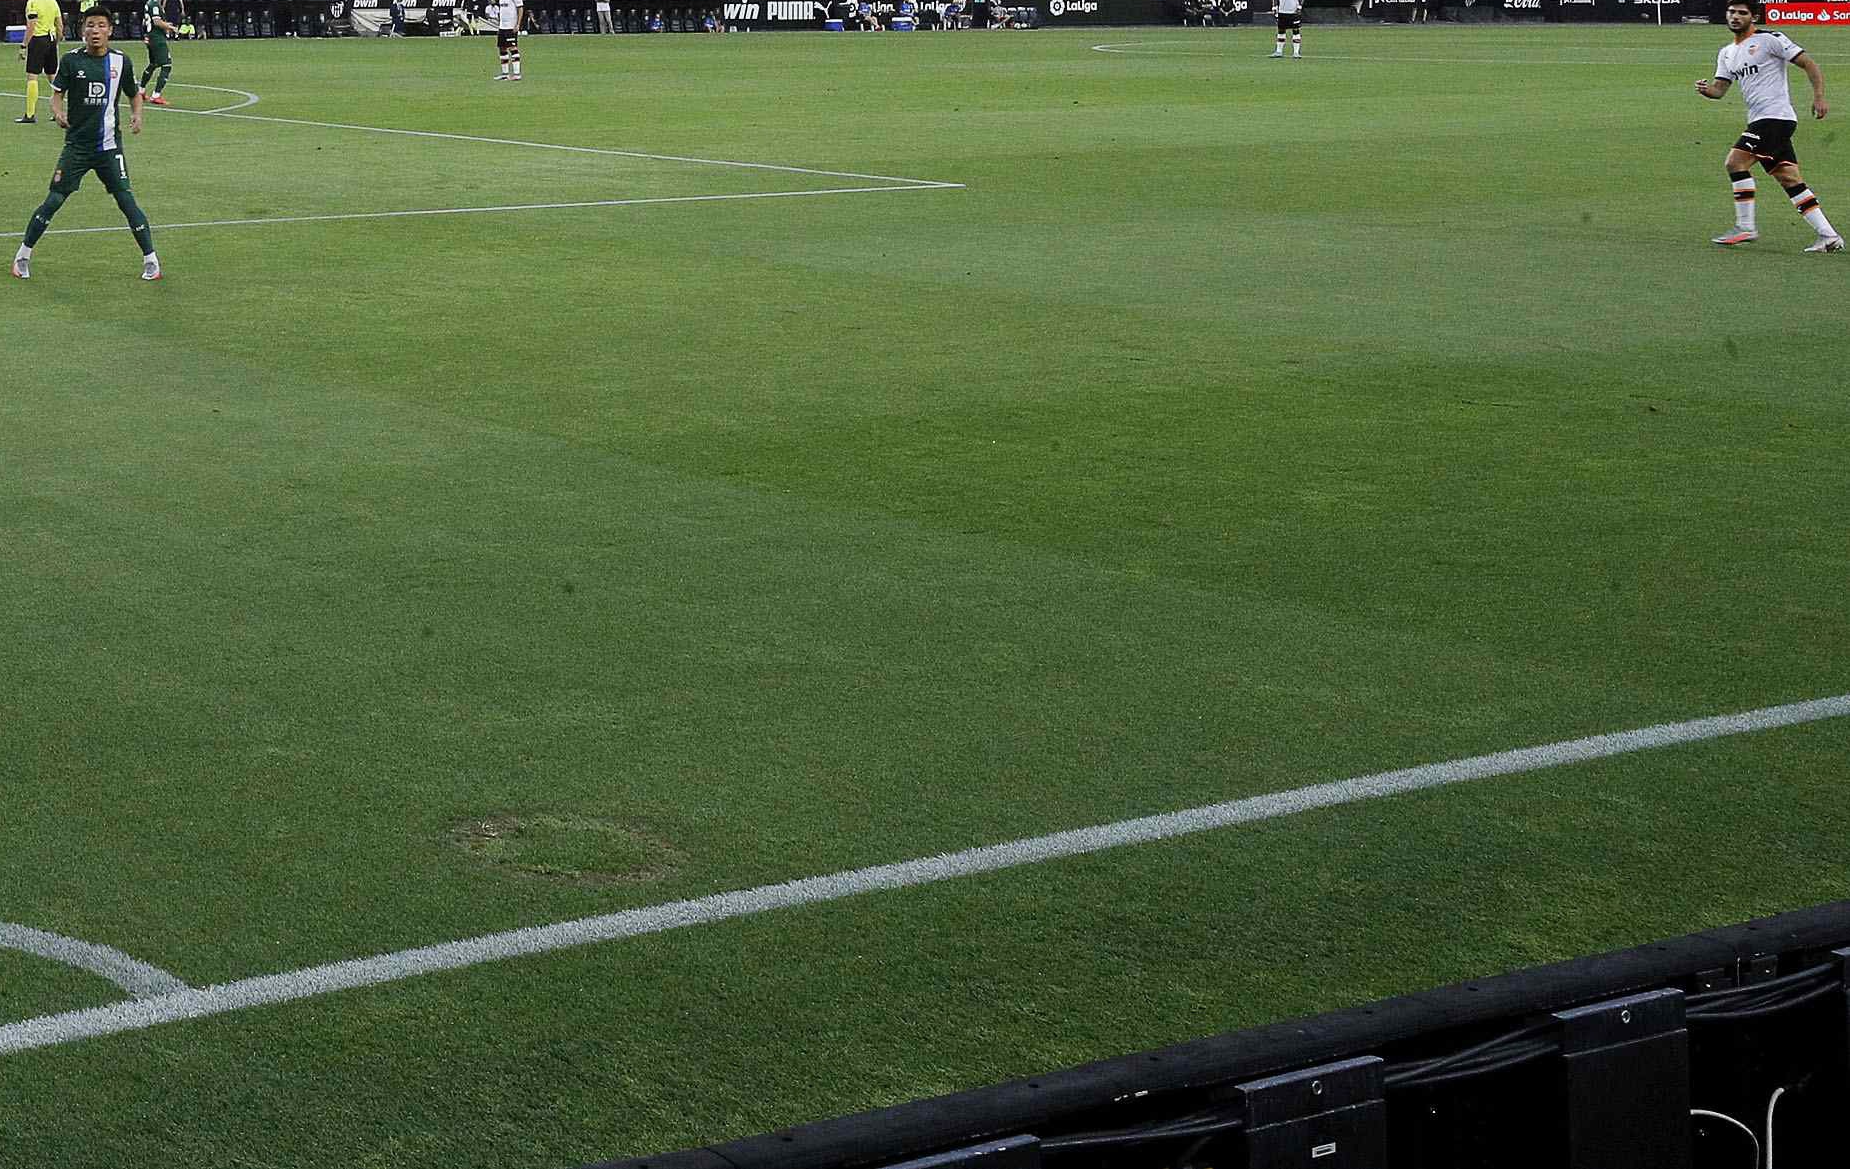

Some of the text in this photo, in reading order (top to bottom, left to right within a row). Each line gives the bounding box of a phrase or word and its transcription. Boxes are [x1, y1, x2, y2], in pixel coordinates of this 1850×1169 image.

[767, 1, 815, 21] PUMA
[1066, 0, 1098, 14] LaLiga
[1781, 10, 1814, 21] LaLiga
